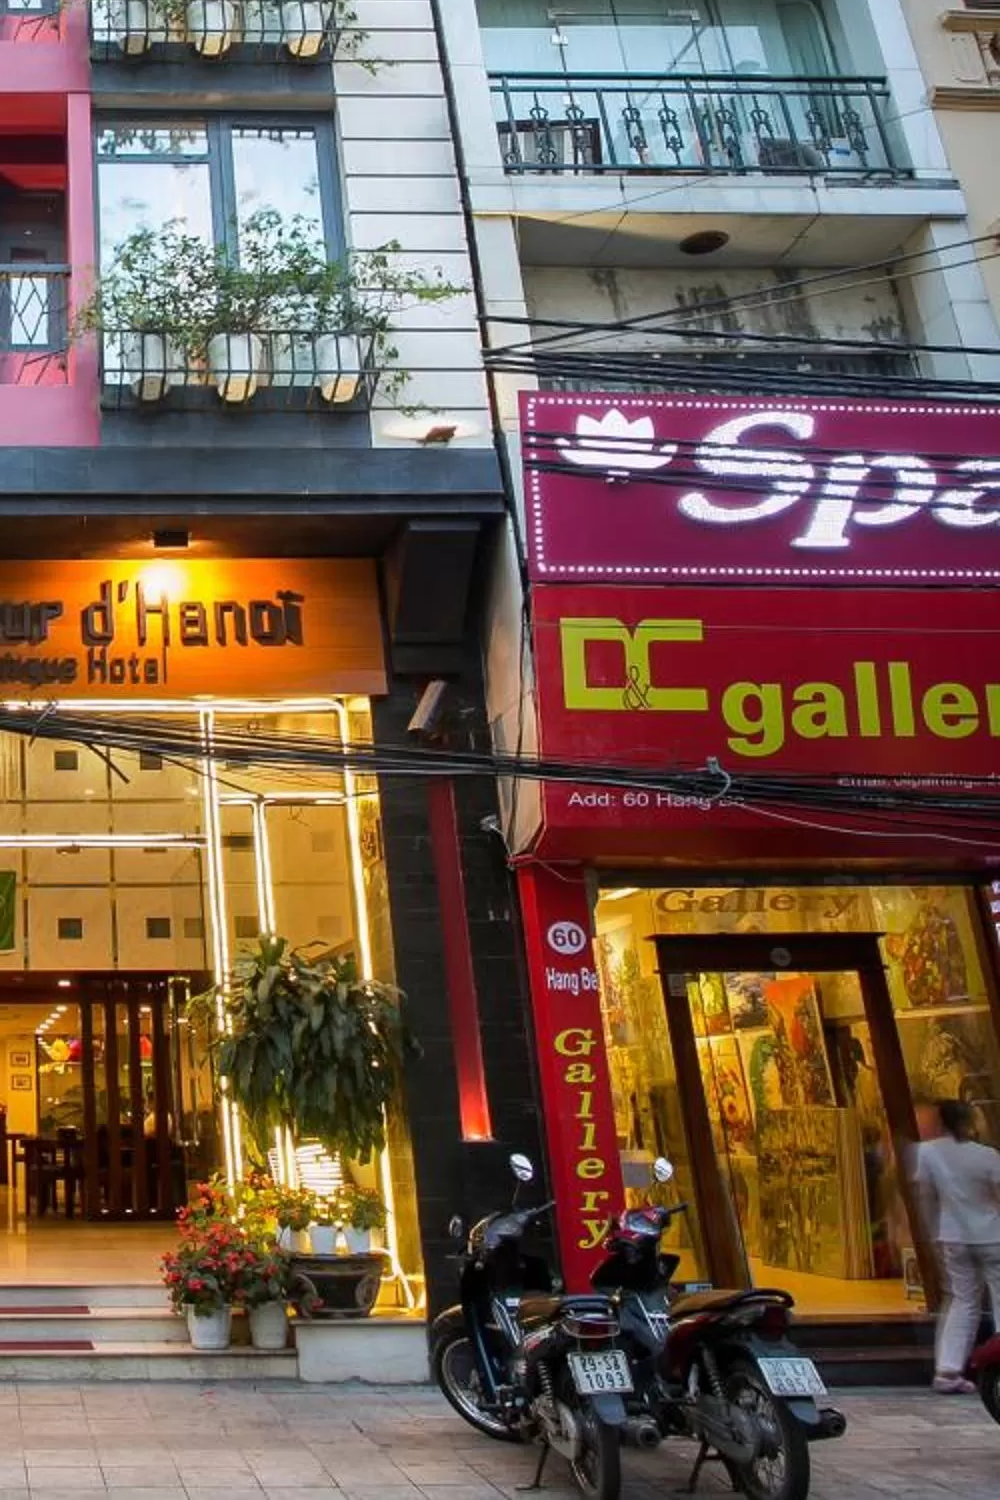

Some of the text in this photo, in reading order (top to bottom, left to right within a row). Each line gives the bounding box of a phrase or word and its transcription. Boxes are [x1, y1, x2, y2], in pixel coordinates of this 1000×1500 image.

[88, 647, 167, 684] Hotel
[568, 792, 617, 807] Add:
[623, 793, 649, 807] 60
[656, 888, 858, 919] Gallery
[552, 928, 581, 947] 60
[545, 967, 579, 996] Hang
[553, 1028, 611, 1249] Gallery
